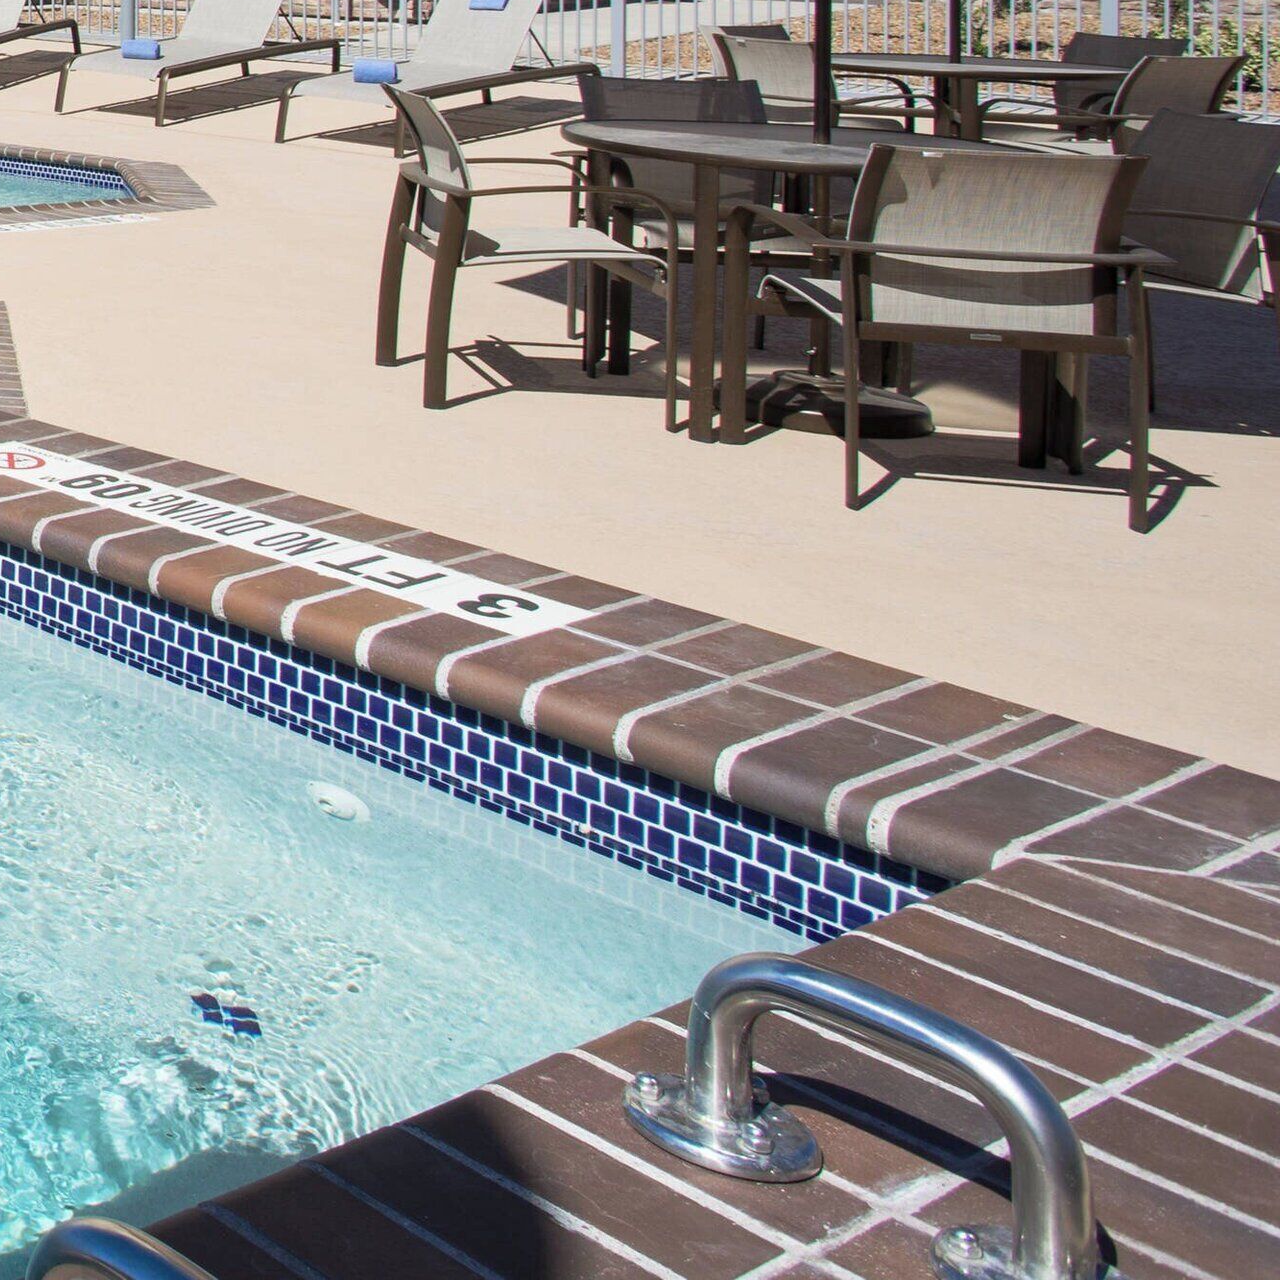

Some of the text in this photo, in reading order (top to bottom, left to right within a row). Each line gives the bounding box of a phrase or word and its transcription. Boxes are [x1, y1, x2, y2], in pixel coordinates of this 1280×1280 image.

[128, 494, 274, 537] DIVING
[253, 532, 339, 556] NO
[315, 555, 447, 589] FT
[457, 593, 539, 618] 3
